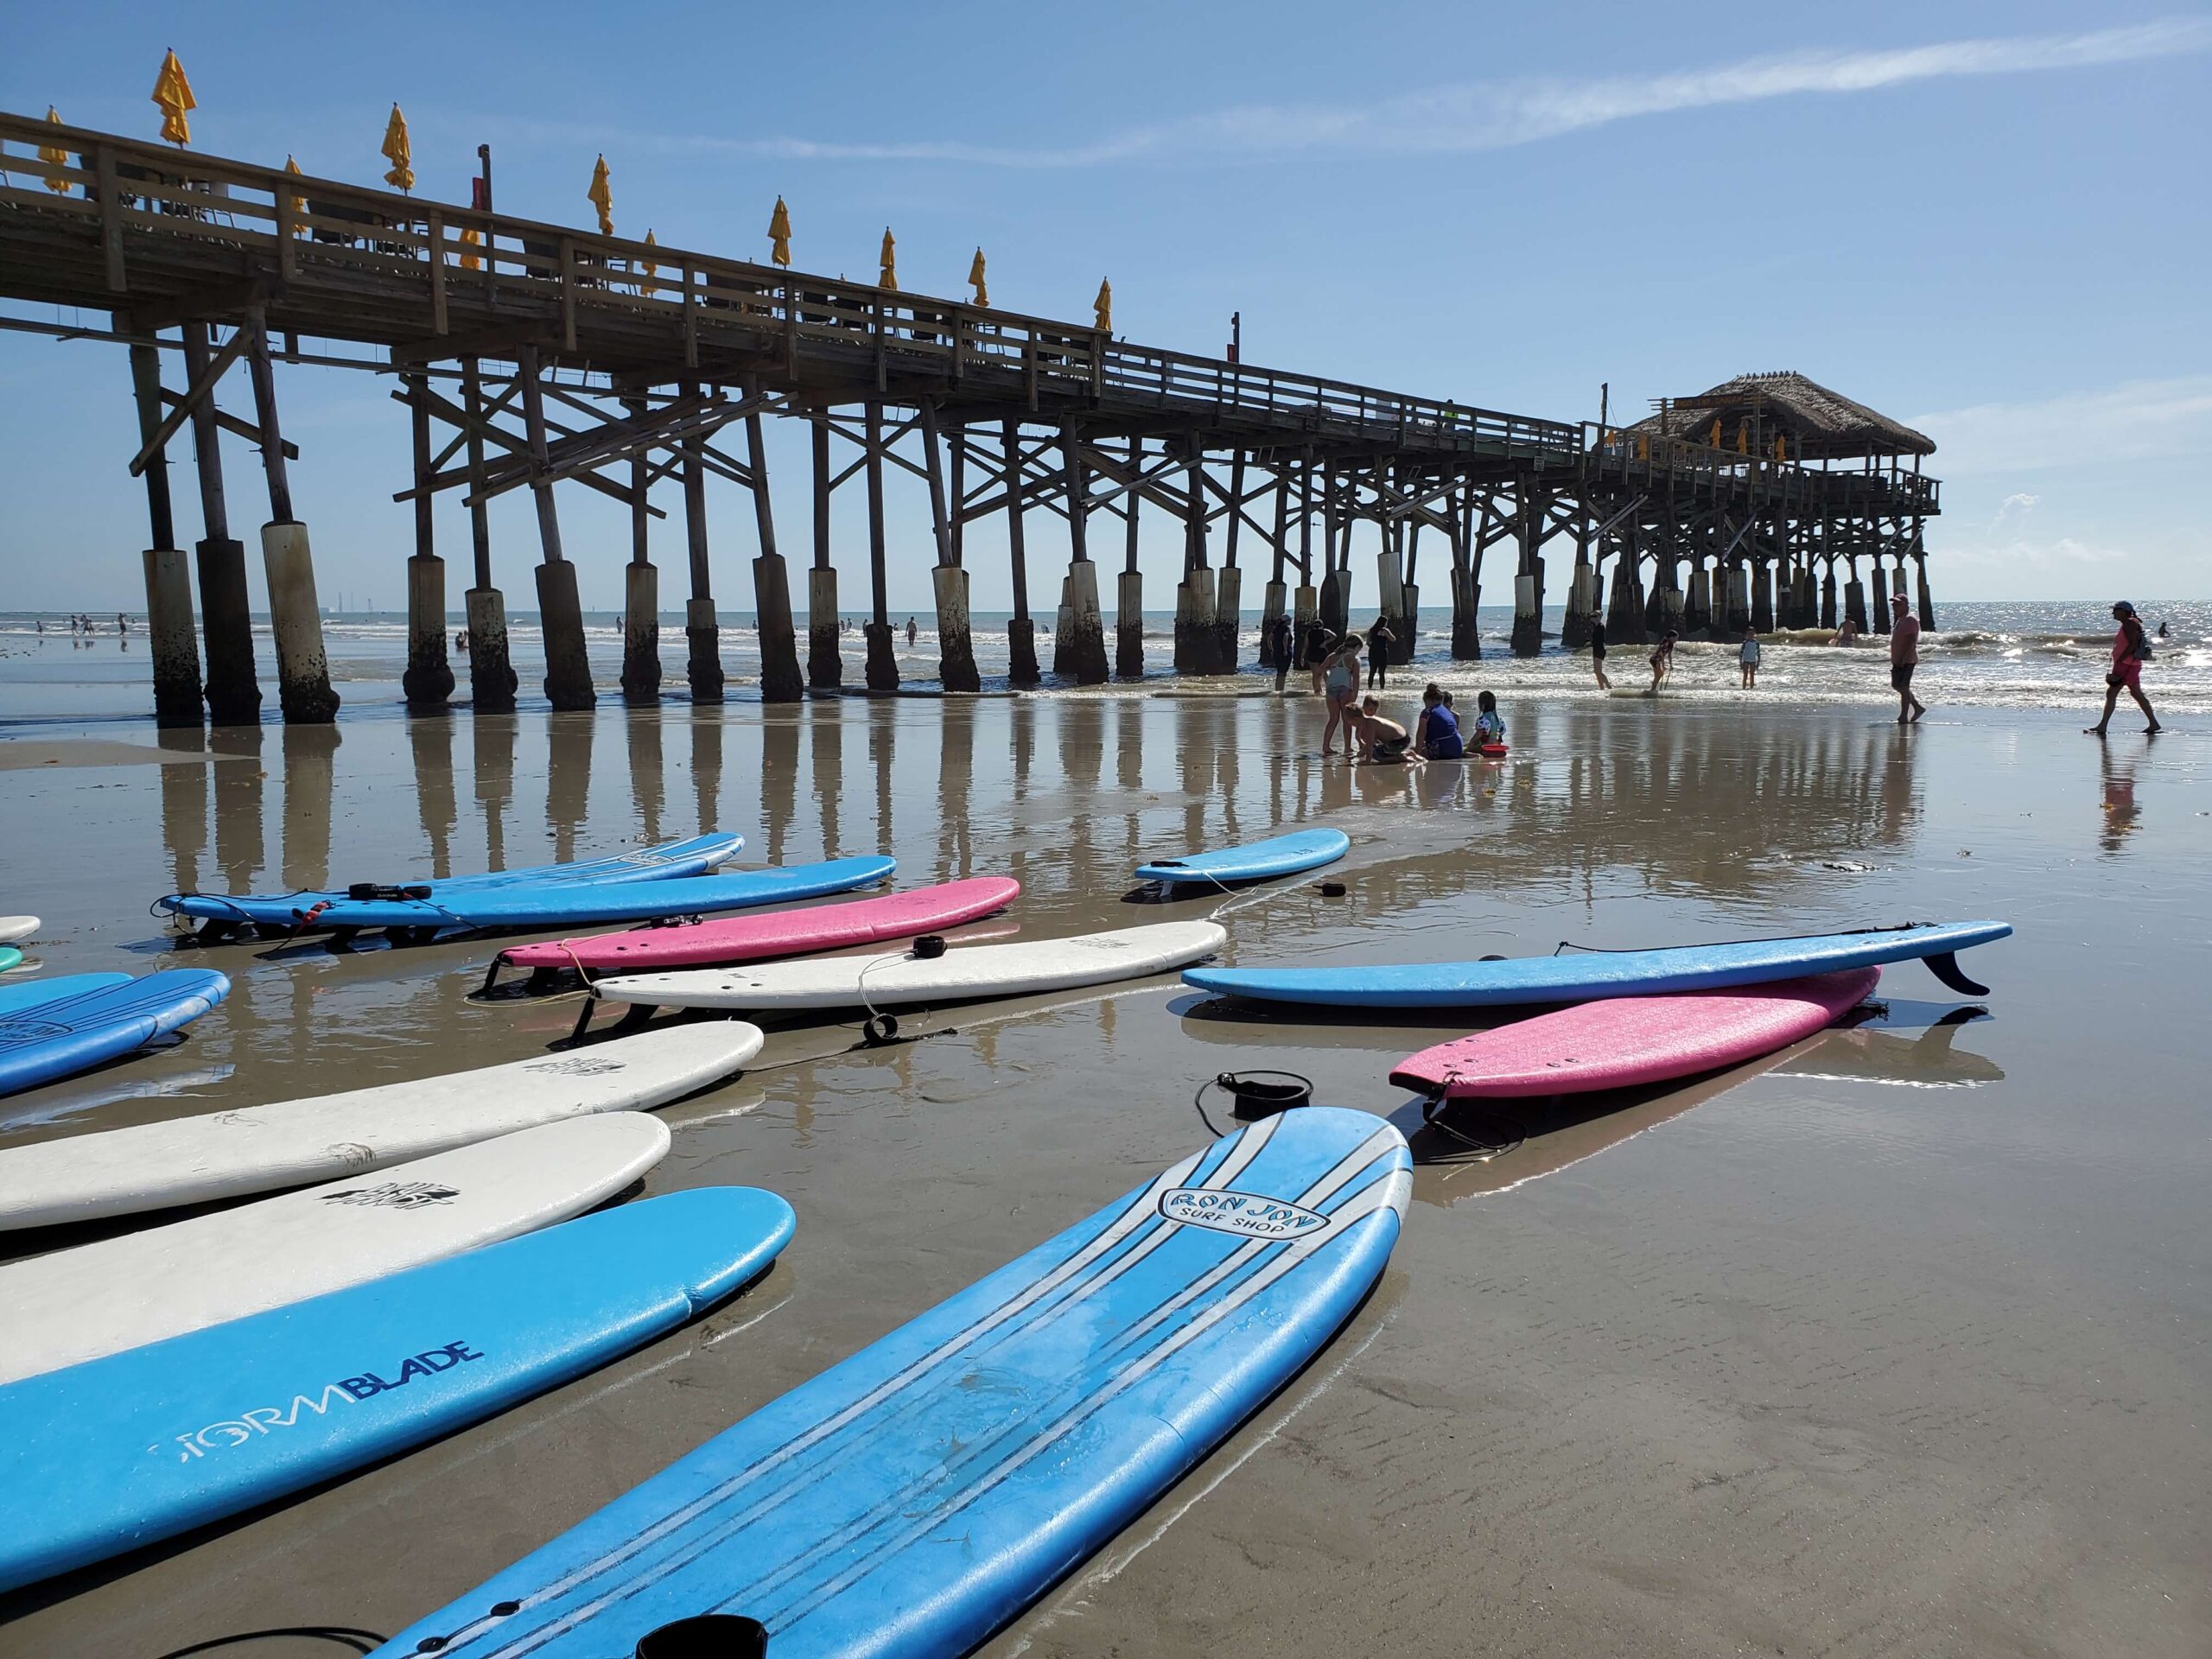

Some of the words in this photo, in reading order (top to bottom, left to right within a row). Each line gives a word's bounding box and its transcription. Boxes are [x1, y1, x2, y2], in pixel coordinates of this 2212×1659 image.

[1170, 1193, 1248, 1211] RON
[1247, 1205, 1318, 1229] JON
[1179, 1207, 1226, 1222] SURF
[1232, 1217, 1285, 1233] SHOP
[147, 1340, 485, 1464] TORMBLADE
